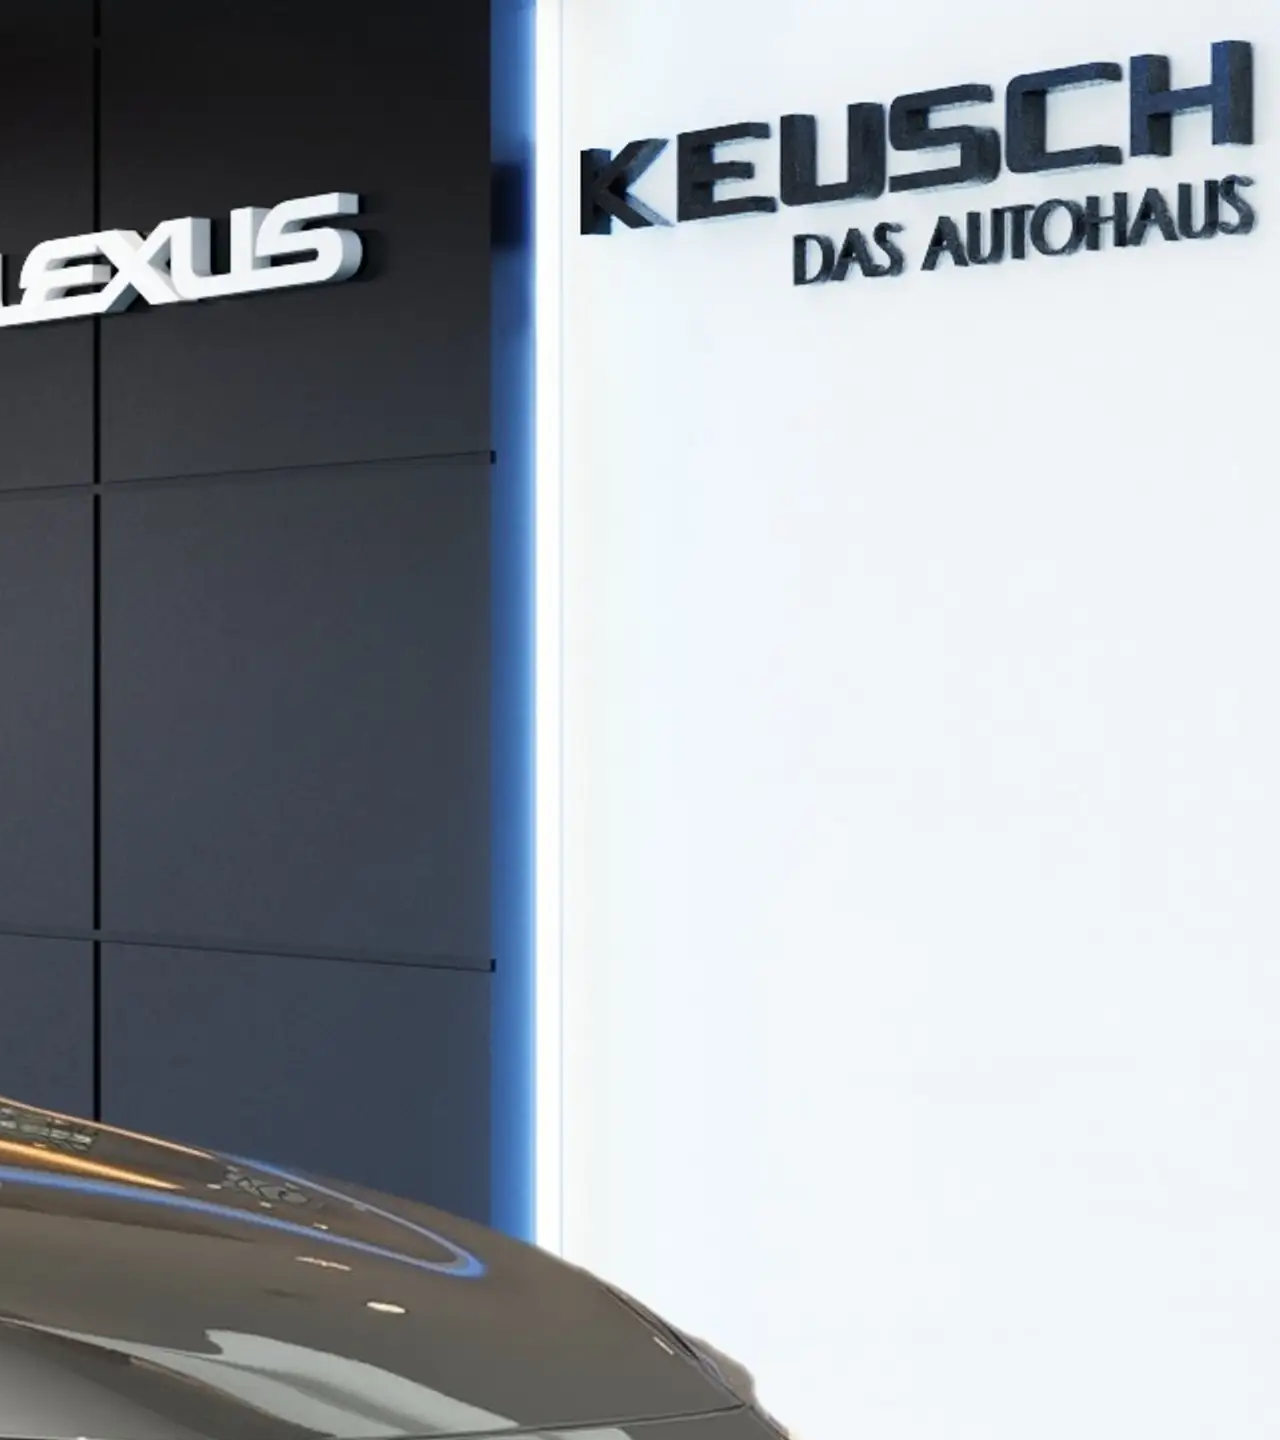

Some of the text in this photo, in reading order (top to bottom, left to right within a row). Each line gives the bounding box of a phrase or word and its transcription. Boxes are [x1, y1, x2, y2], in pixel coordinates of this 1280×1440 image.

[579, 39, 1255, 236] KEUSCH
[792, 174, 1256, 286] DAS AUTOHAUS
